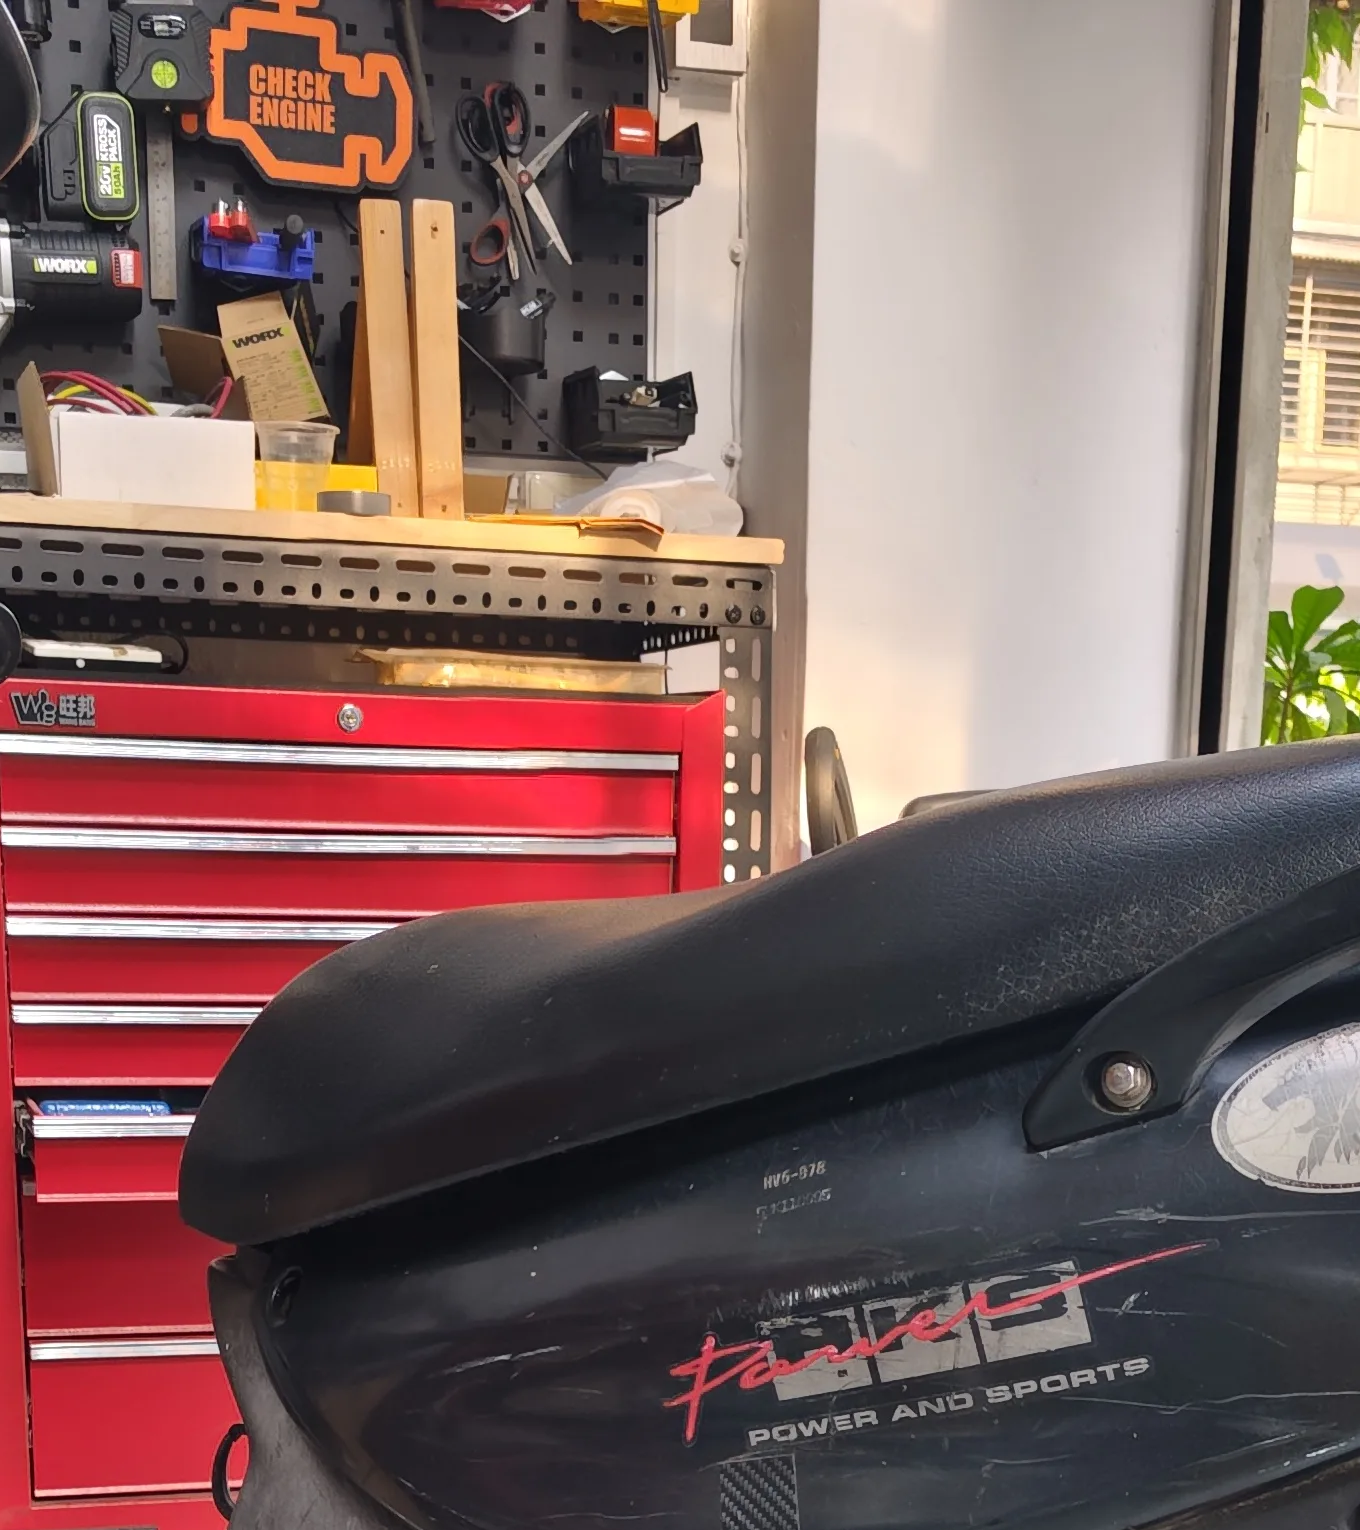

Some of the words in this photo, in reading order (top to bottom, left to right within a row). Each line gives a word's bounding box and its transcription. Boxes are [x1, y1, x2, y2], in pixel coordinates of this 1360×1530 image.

[249, 64, 332, 103] CHECK
[249, 94, 336, 135] ENGINE
[37, 257, 88, 275] WORX
[231, 327, 285, 349] WORX
[58, 695, 96, 719] 旺邦
[747, 1410, 878, 1448] POWER
[891, 1391, 975, 1424] AND
[986, 1355, 1152, 1406] SPORTS
